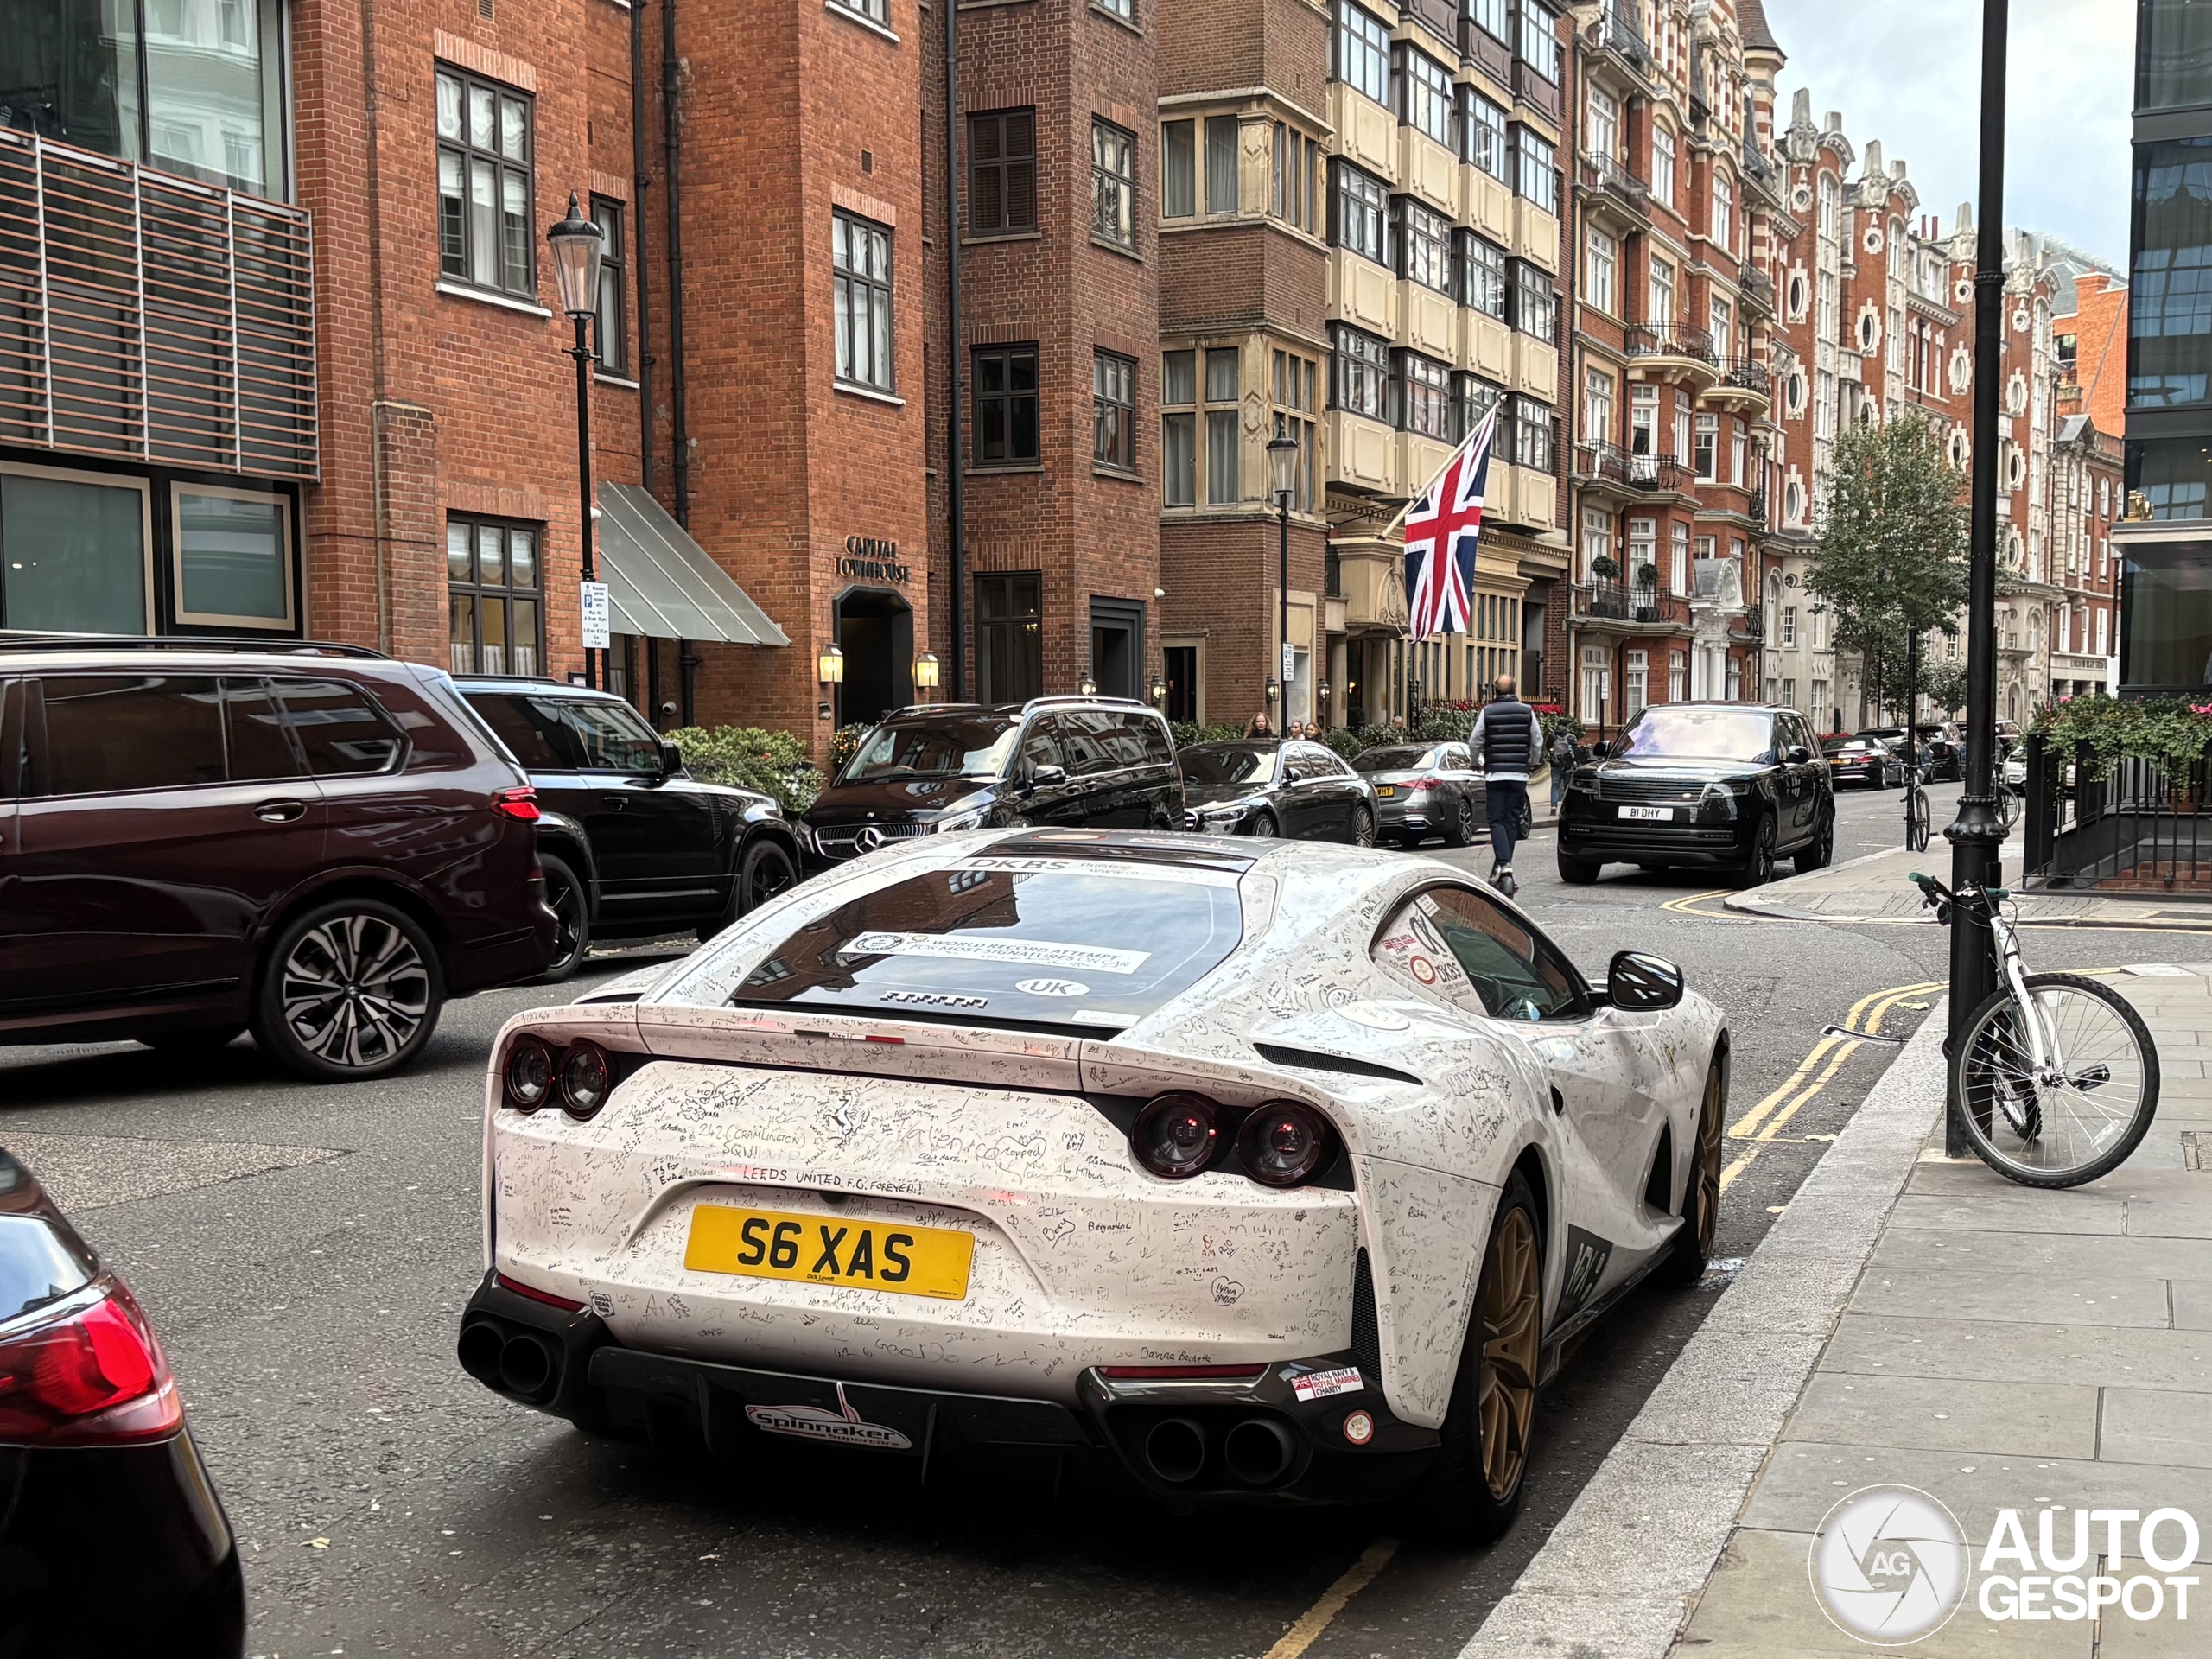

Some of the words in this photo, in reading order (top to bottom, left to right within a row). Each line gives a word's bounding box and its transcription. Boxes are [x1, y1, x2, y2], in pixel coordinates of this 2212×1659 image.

[846, 535, 898, 560] CAPITAL
[834, 556, 911, 583] TOWNHOUSE
[1642, 809, 1661, 817] DHY
[968, 859, 1070, 870] DKBS
[938, 945, 981, 954] MOST
[985, 947, 1077, 961] SIGNATURES
[987, 944, 1049, 953] RECORD
[1049, 949, 1122, 960] ATTEMPT
[1435, 963, 1462, 983] DKBS
[1030, 981, 1073, 995] UK
[742, 1166, 787, 1182] LEEDS
[796, 1172, 841, 1186] UNITED
[870, 1180, 922, 1195] FOREVER!
[737, 1217, 802, 1269] S6
[812, 1225, 914, 1283] XAS
[1311, 1371, 1332, 1382] ROYAL
[1332, 1369, 1349, 1378] NAVY
[1313, 1379, 1334, 1389] ROYAL
[1316, 1385, 1342, 1396] CHARITY
[756, 1413, 895, 1440] Spinnaker
[828, 1433, 900, 1446] Supercars
